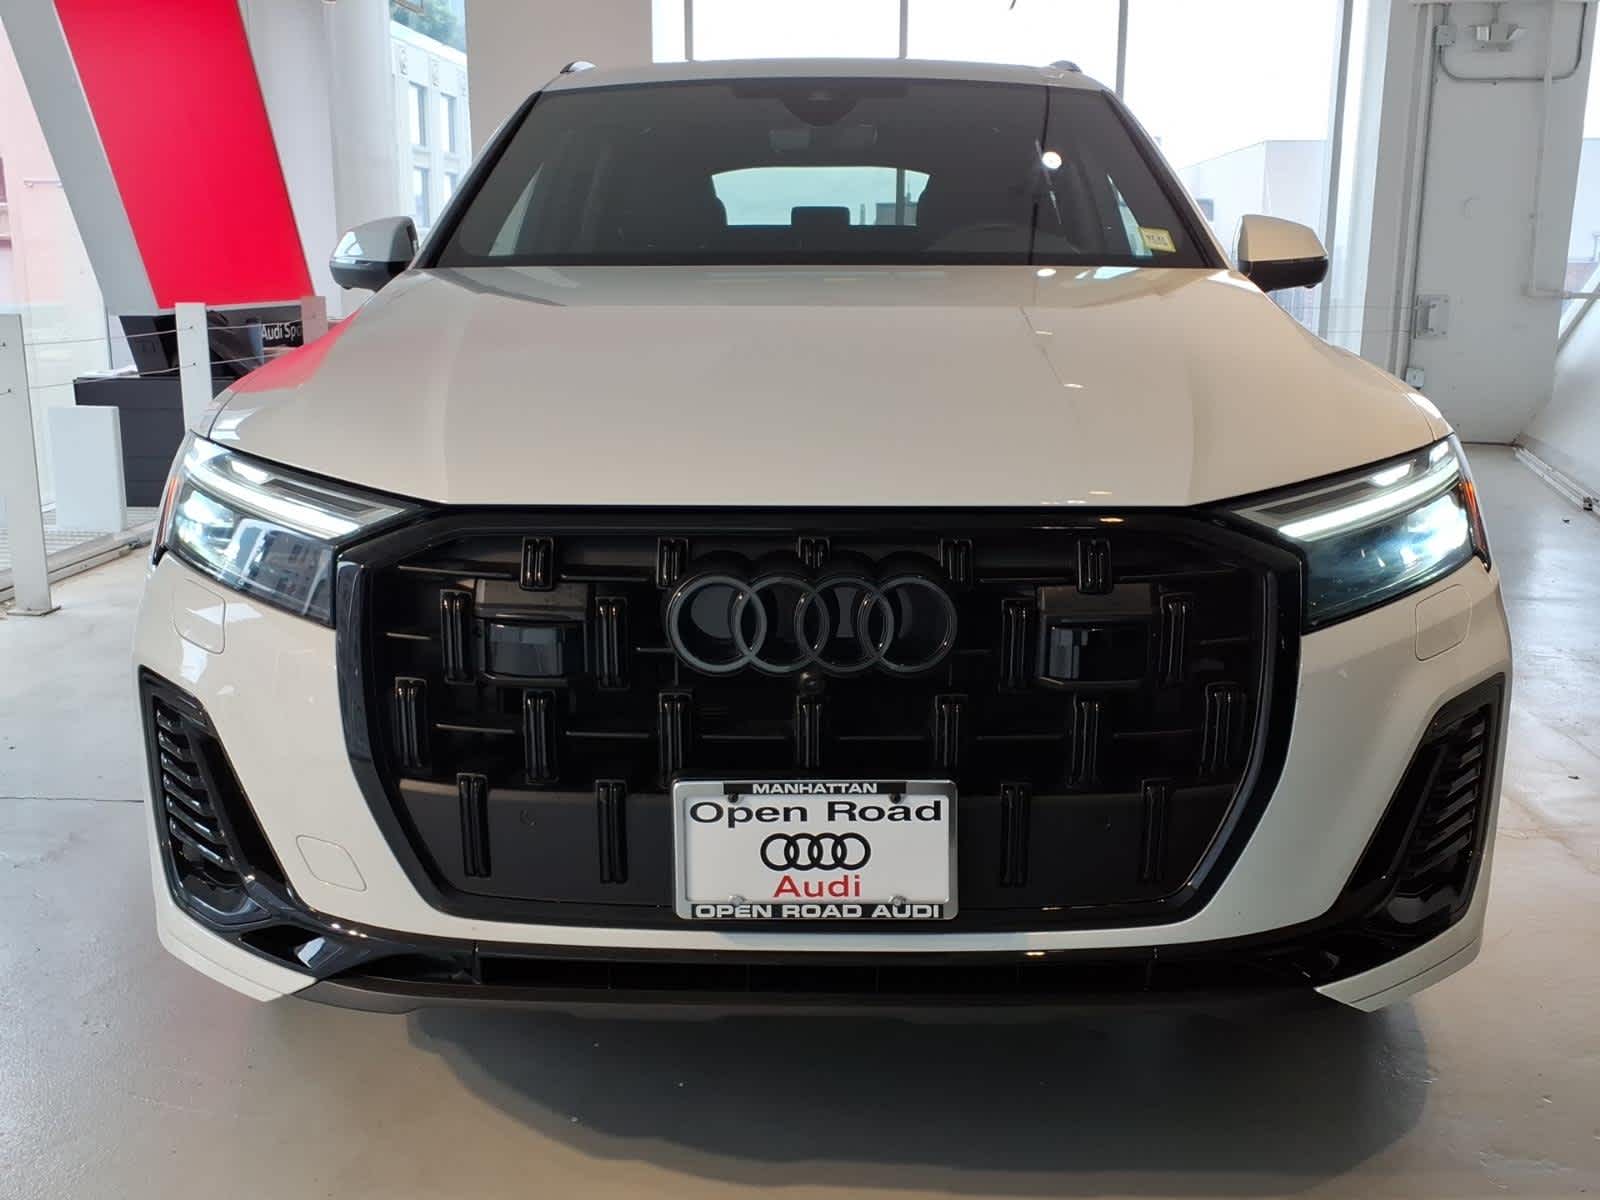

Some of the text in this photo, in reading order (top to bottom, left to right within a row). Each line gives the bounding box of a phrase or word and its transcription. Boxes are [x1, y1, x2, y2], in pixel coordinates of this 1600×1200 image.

[262, 324, 283, 340] Audi
[752, 783, 877, 794] MANHATTAN
[690, 800, 941, 828] Open Road
[773, 875, 861, 898] Audi
[695, 904, 939, 918] OPEN ROAD AUDI
